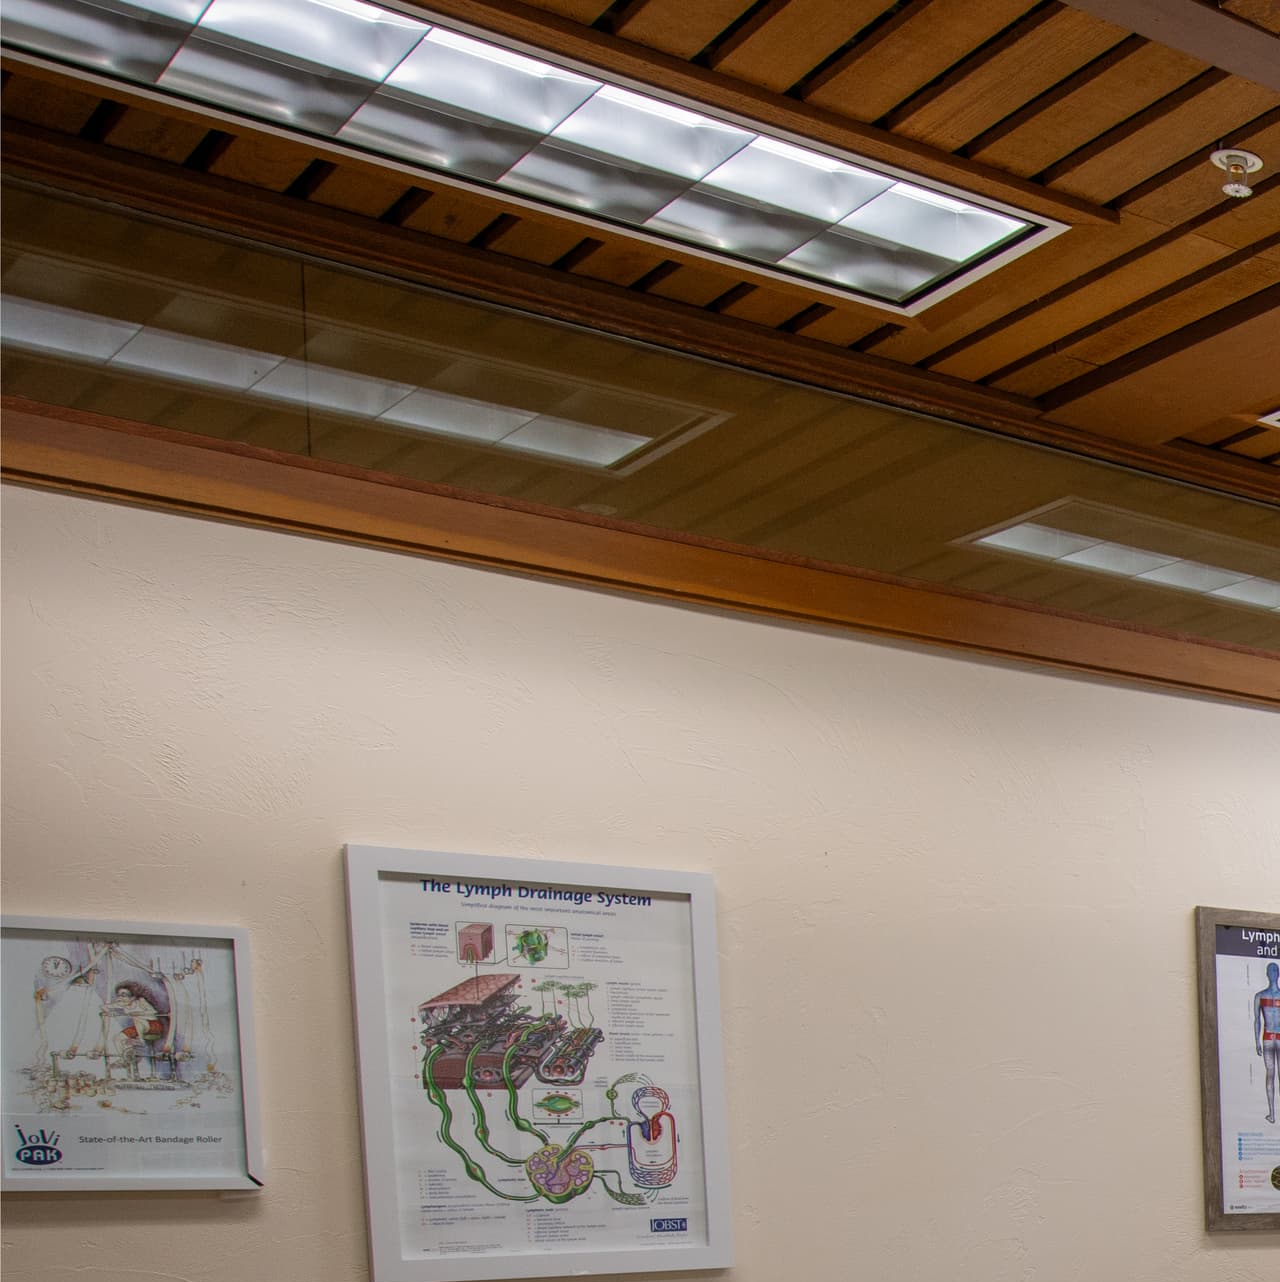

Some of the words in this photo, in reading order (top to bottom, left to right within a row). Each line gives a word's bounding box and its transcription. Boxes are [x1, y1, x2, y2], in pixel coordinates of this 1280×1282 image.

[420, 879, 451, 893] The
[456, 881, 513, 898] Lymph
[518, 886, 593, 905] Drainage
[597, 891, 652, 907] System
[1256, 944, 1278, 957] and
[79, 1135, 153, 1144] State-of-the-Art
[155, 1135, 194, 1145] Bandage
[196, 1135, 223, 1144] Roller
[20, 1150, 57, 1161] PAK
[652, 1219, 682, 1232] JOBST
